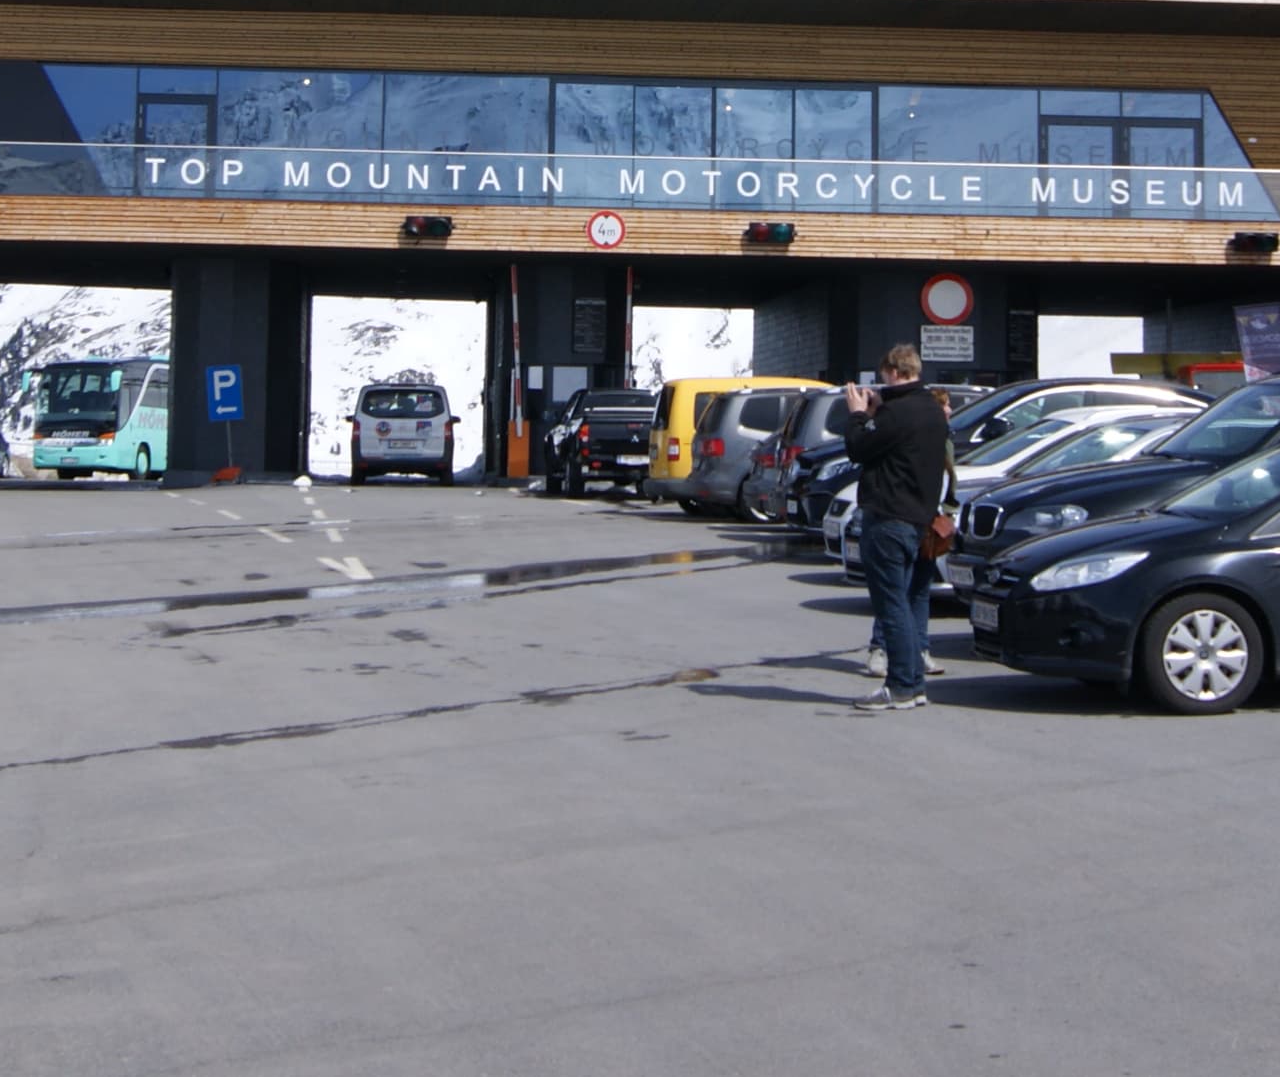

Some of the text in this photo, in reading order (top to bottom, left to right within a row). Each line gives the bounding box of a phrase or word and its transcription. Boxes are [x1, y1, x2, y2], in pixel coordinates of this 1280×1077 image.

[144, 158, 1245, 207] TOP MOUNTAIN MOTORCYCLE MUSEUM
[213, 369, 237, 401] P
